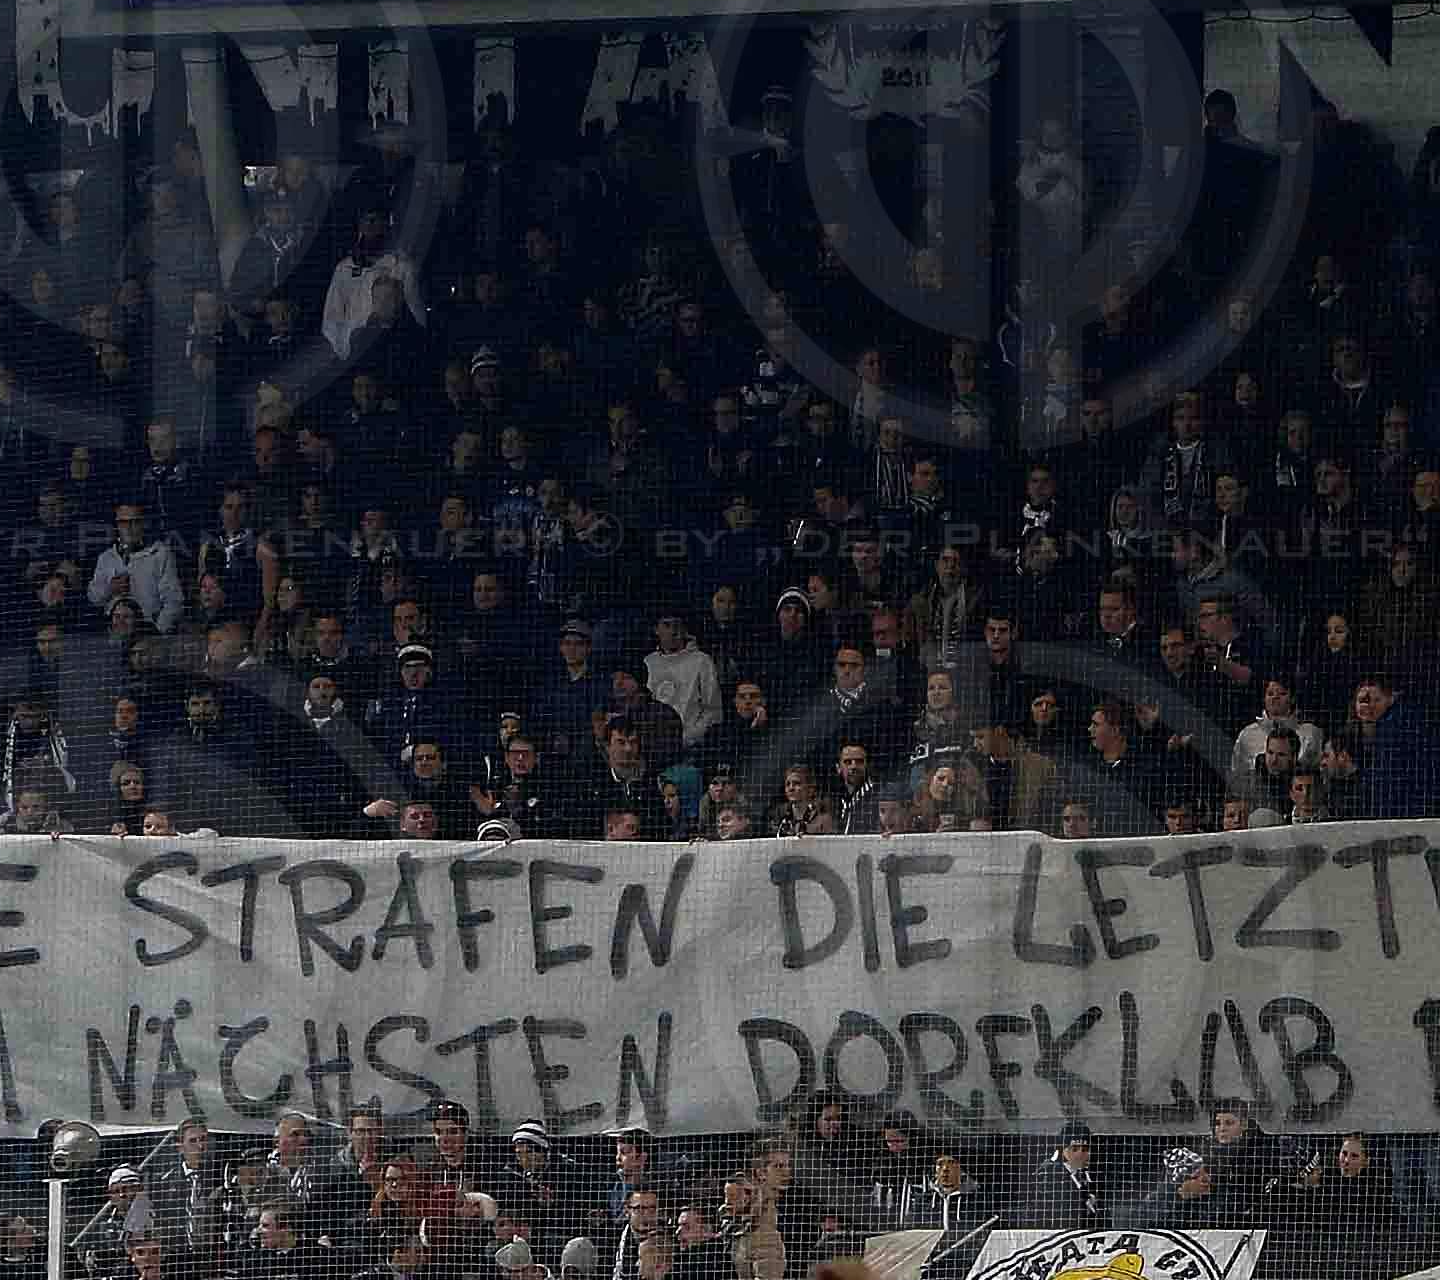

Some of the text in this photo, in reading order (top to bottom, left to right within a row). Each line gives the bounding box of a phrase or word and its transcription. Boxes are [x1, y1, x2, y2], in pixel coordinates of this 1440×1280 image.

[122, 850, 697, 980] STRAFEN
[769, 852, 955, 973] DIE
[85, 998, 673, 1131] NÄCHSTEN
[737, 990, 1354, 1122] DORFKLUB
